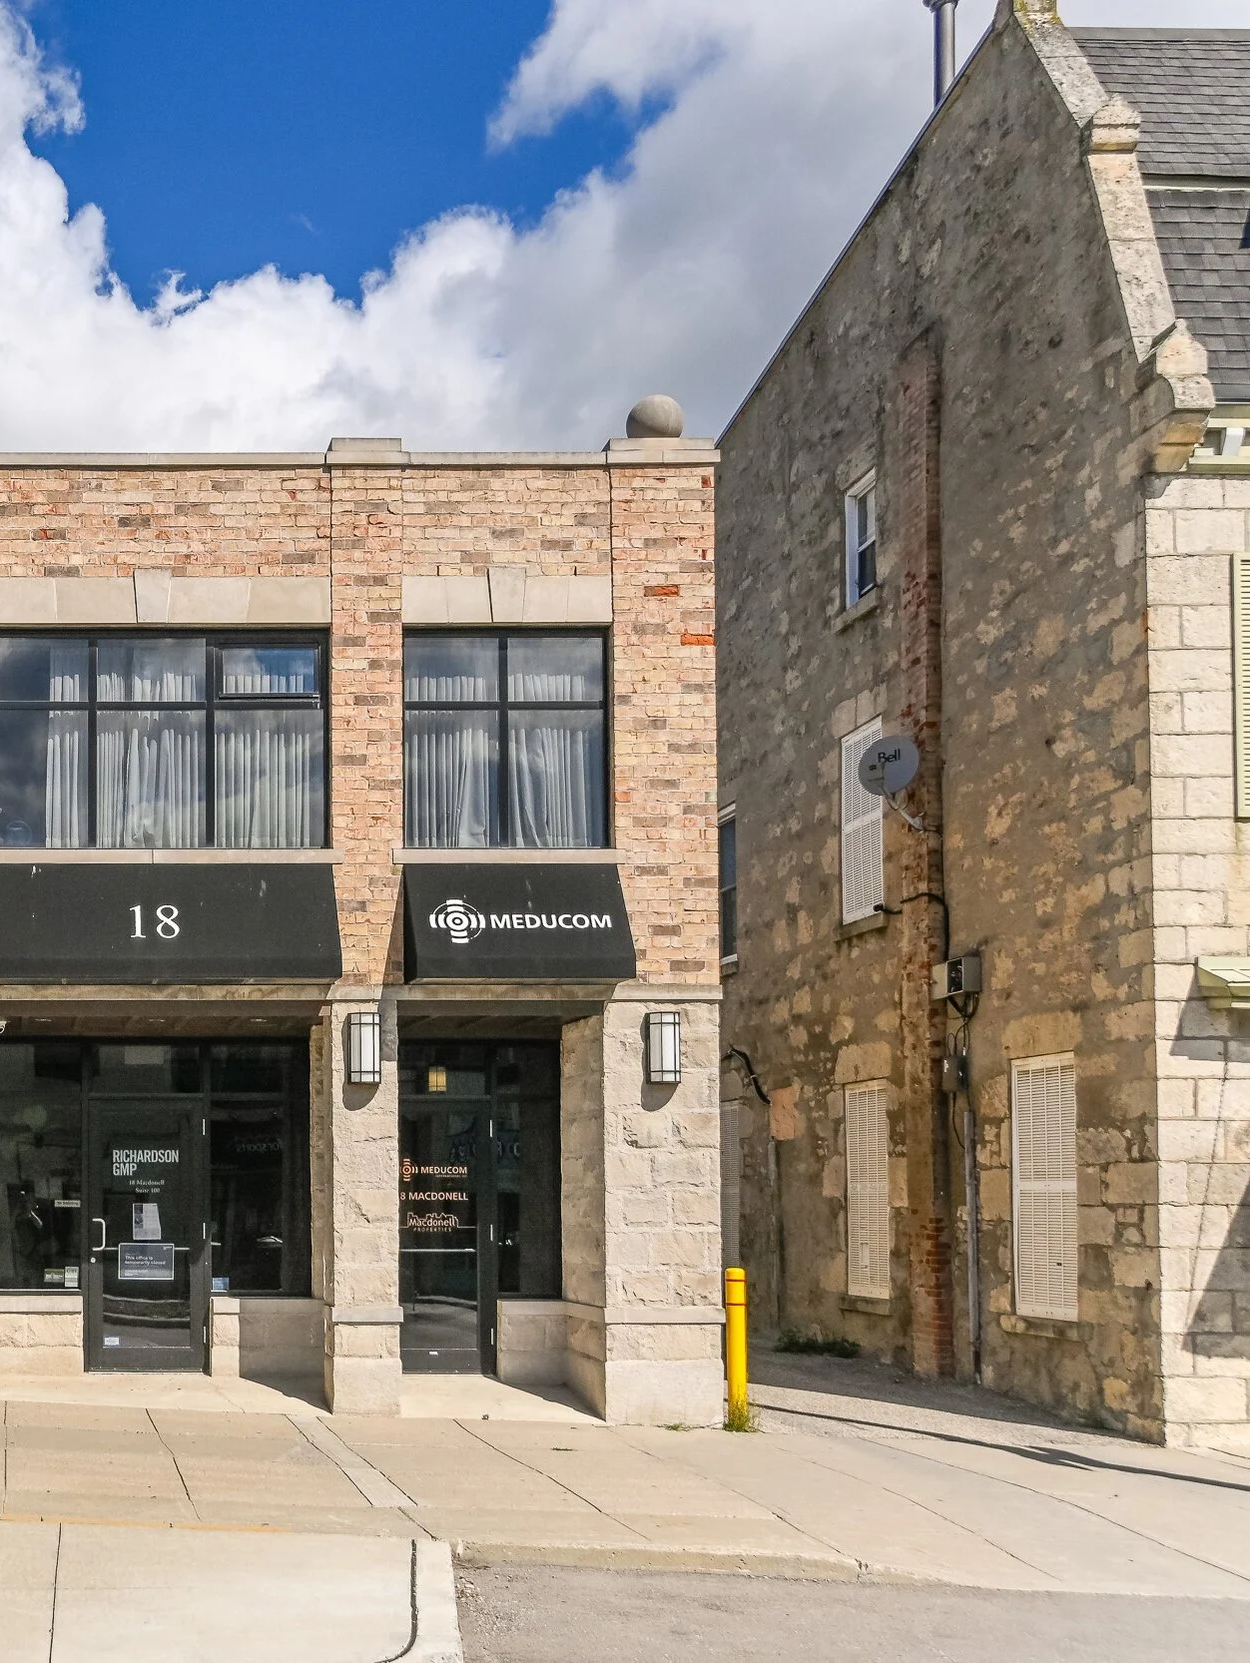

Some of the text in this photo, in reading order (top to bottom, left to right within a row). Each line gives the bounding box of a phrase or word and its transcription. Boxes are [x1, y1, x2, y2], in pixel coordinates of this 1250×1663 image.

[877, 748, 901, 763] Bell
[129, 904, 180, 939] 18
[489, 913, 612, 929] MEDUCOM
[112, 1149, 179, 1162] RICHARDSON
[112, 1163, 137, 1176] GMP
[420, 1166, 468, 1174] MEDUCOM
[408, 1192, 468, 1200] MACDONELL
[409, 1217, 456, 1227] Macdonell
